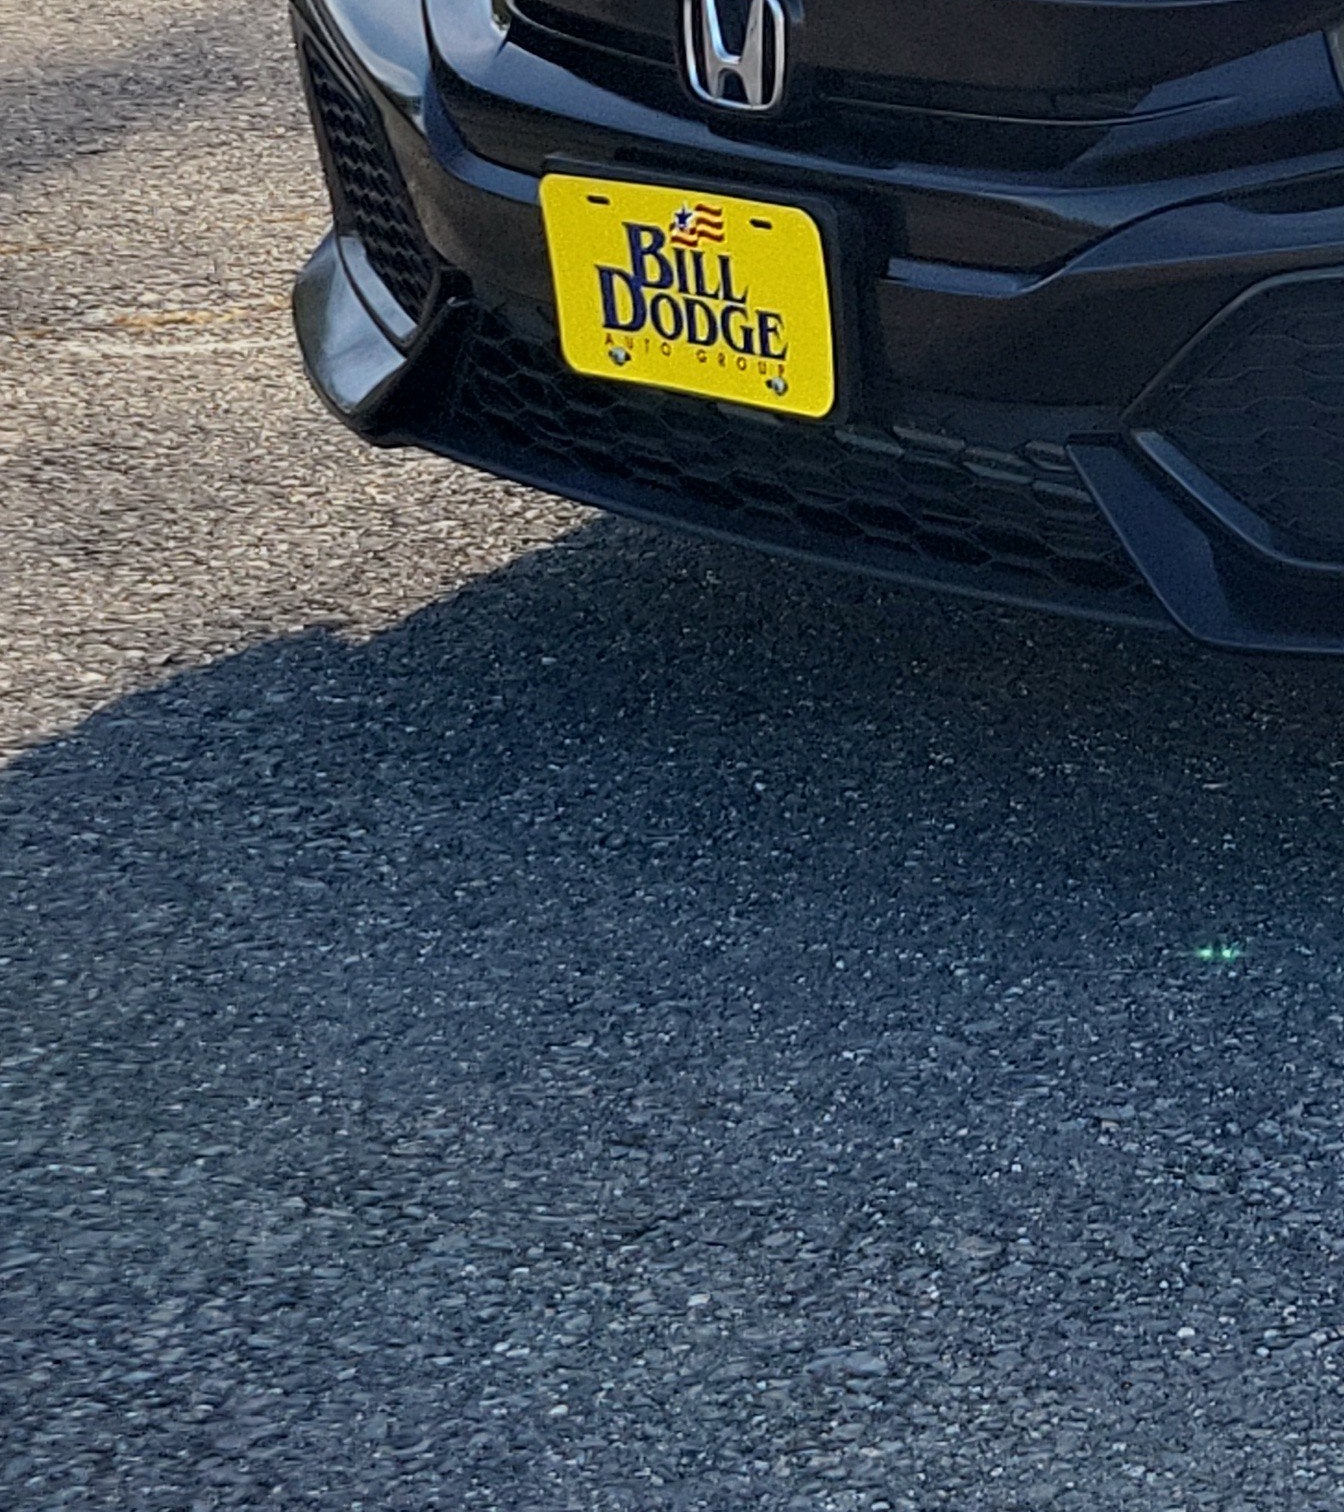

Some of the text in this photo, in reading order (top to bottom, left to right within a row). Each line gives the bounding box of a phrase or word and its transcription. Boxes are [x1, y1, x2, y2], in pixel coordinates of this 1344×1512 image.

[621, 221, 748, 304] BILL
[595, 264, 788, 360] DODGE
[605, 333, 785, 376] AUTO GROUP
